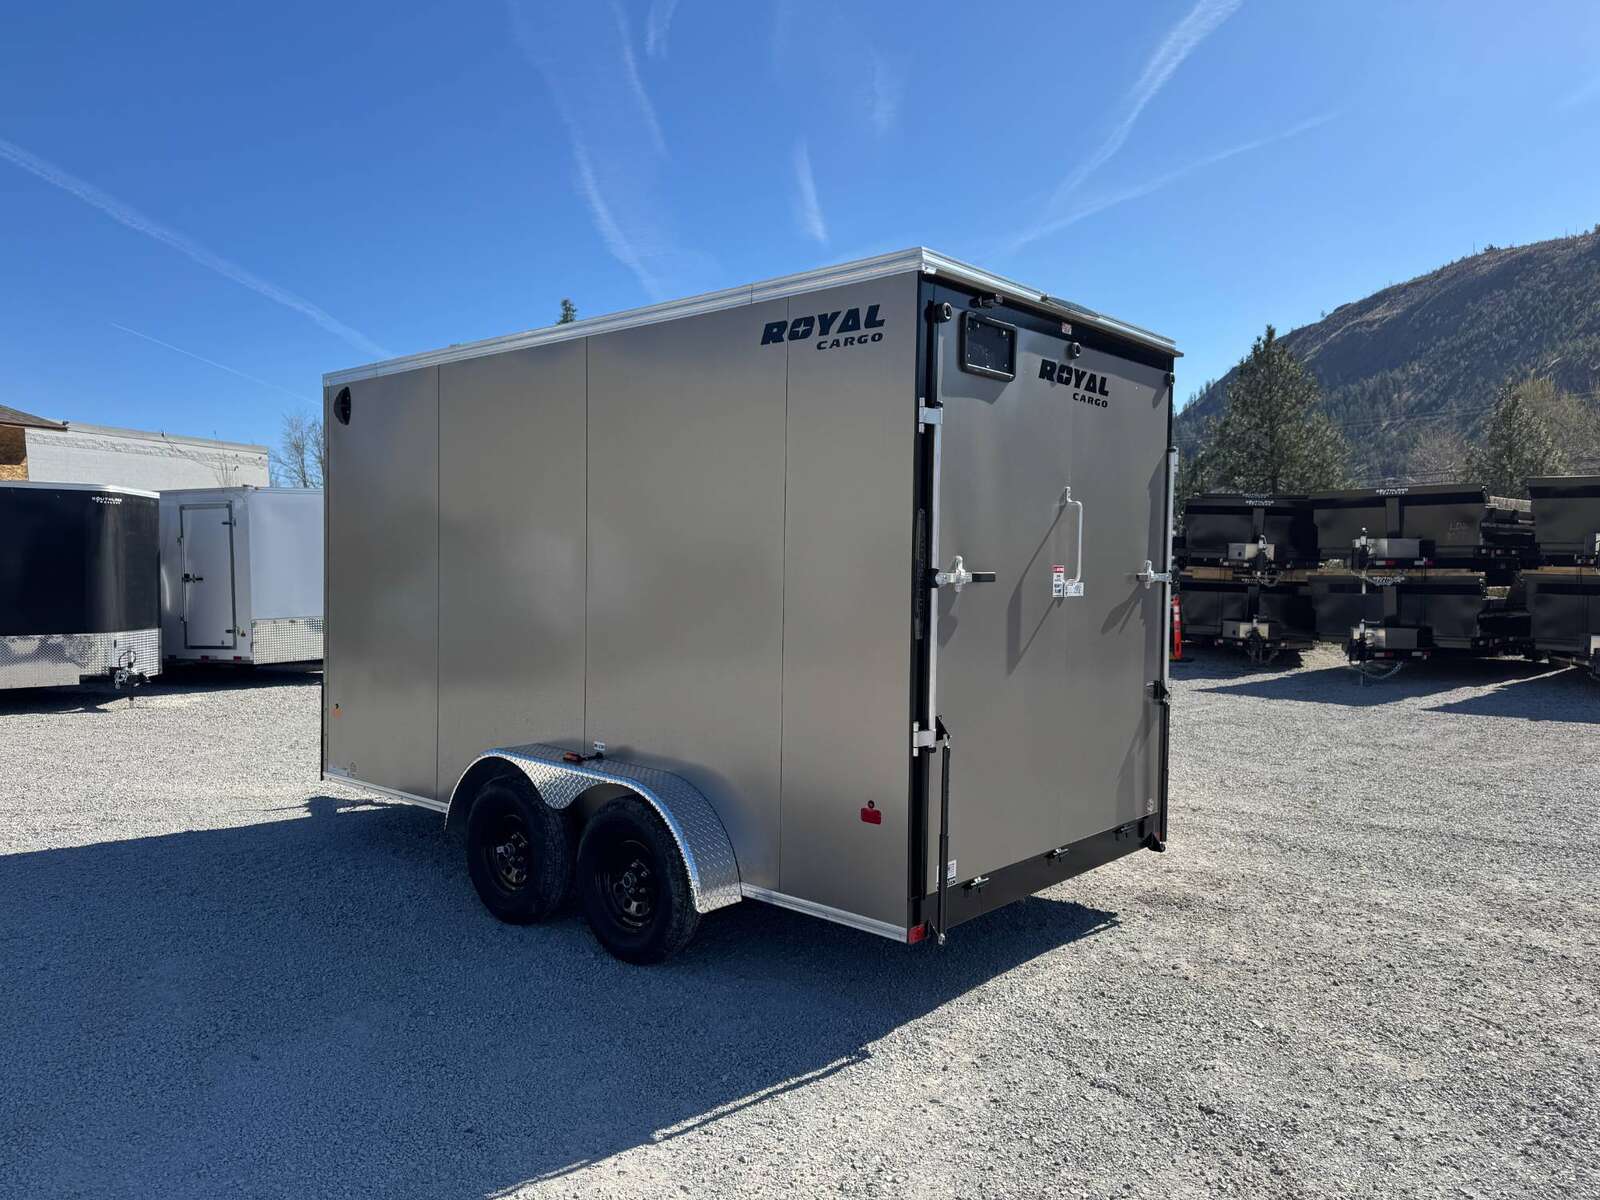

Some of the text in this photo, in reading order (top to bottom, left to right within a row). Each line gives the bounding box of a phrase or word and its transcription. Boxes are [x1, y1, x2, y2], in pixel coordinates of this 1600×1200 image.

[760, 304, 885, 345] ROYAL
[816, 332, 884, 350] CARGO
[1038, 358, 1109, 397] ROYAL
[1072, 392, 1108, 408] CARGO
